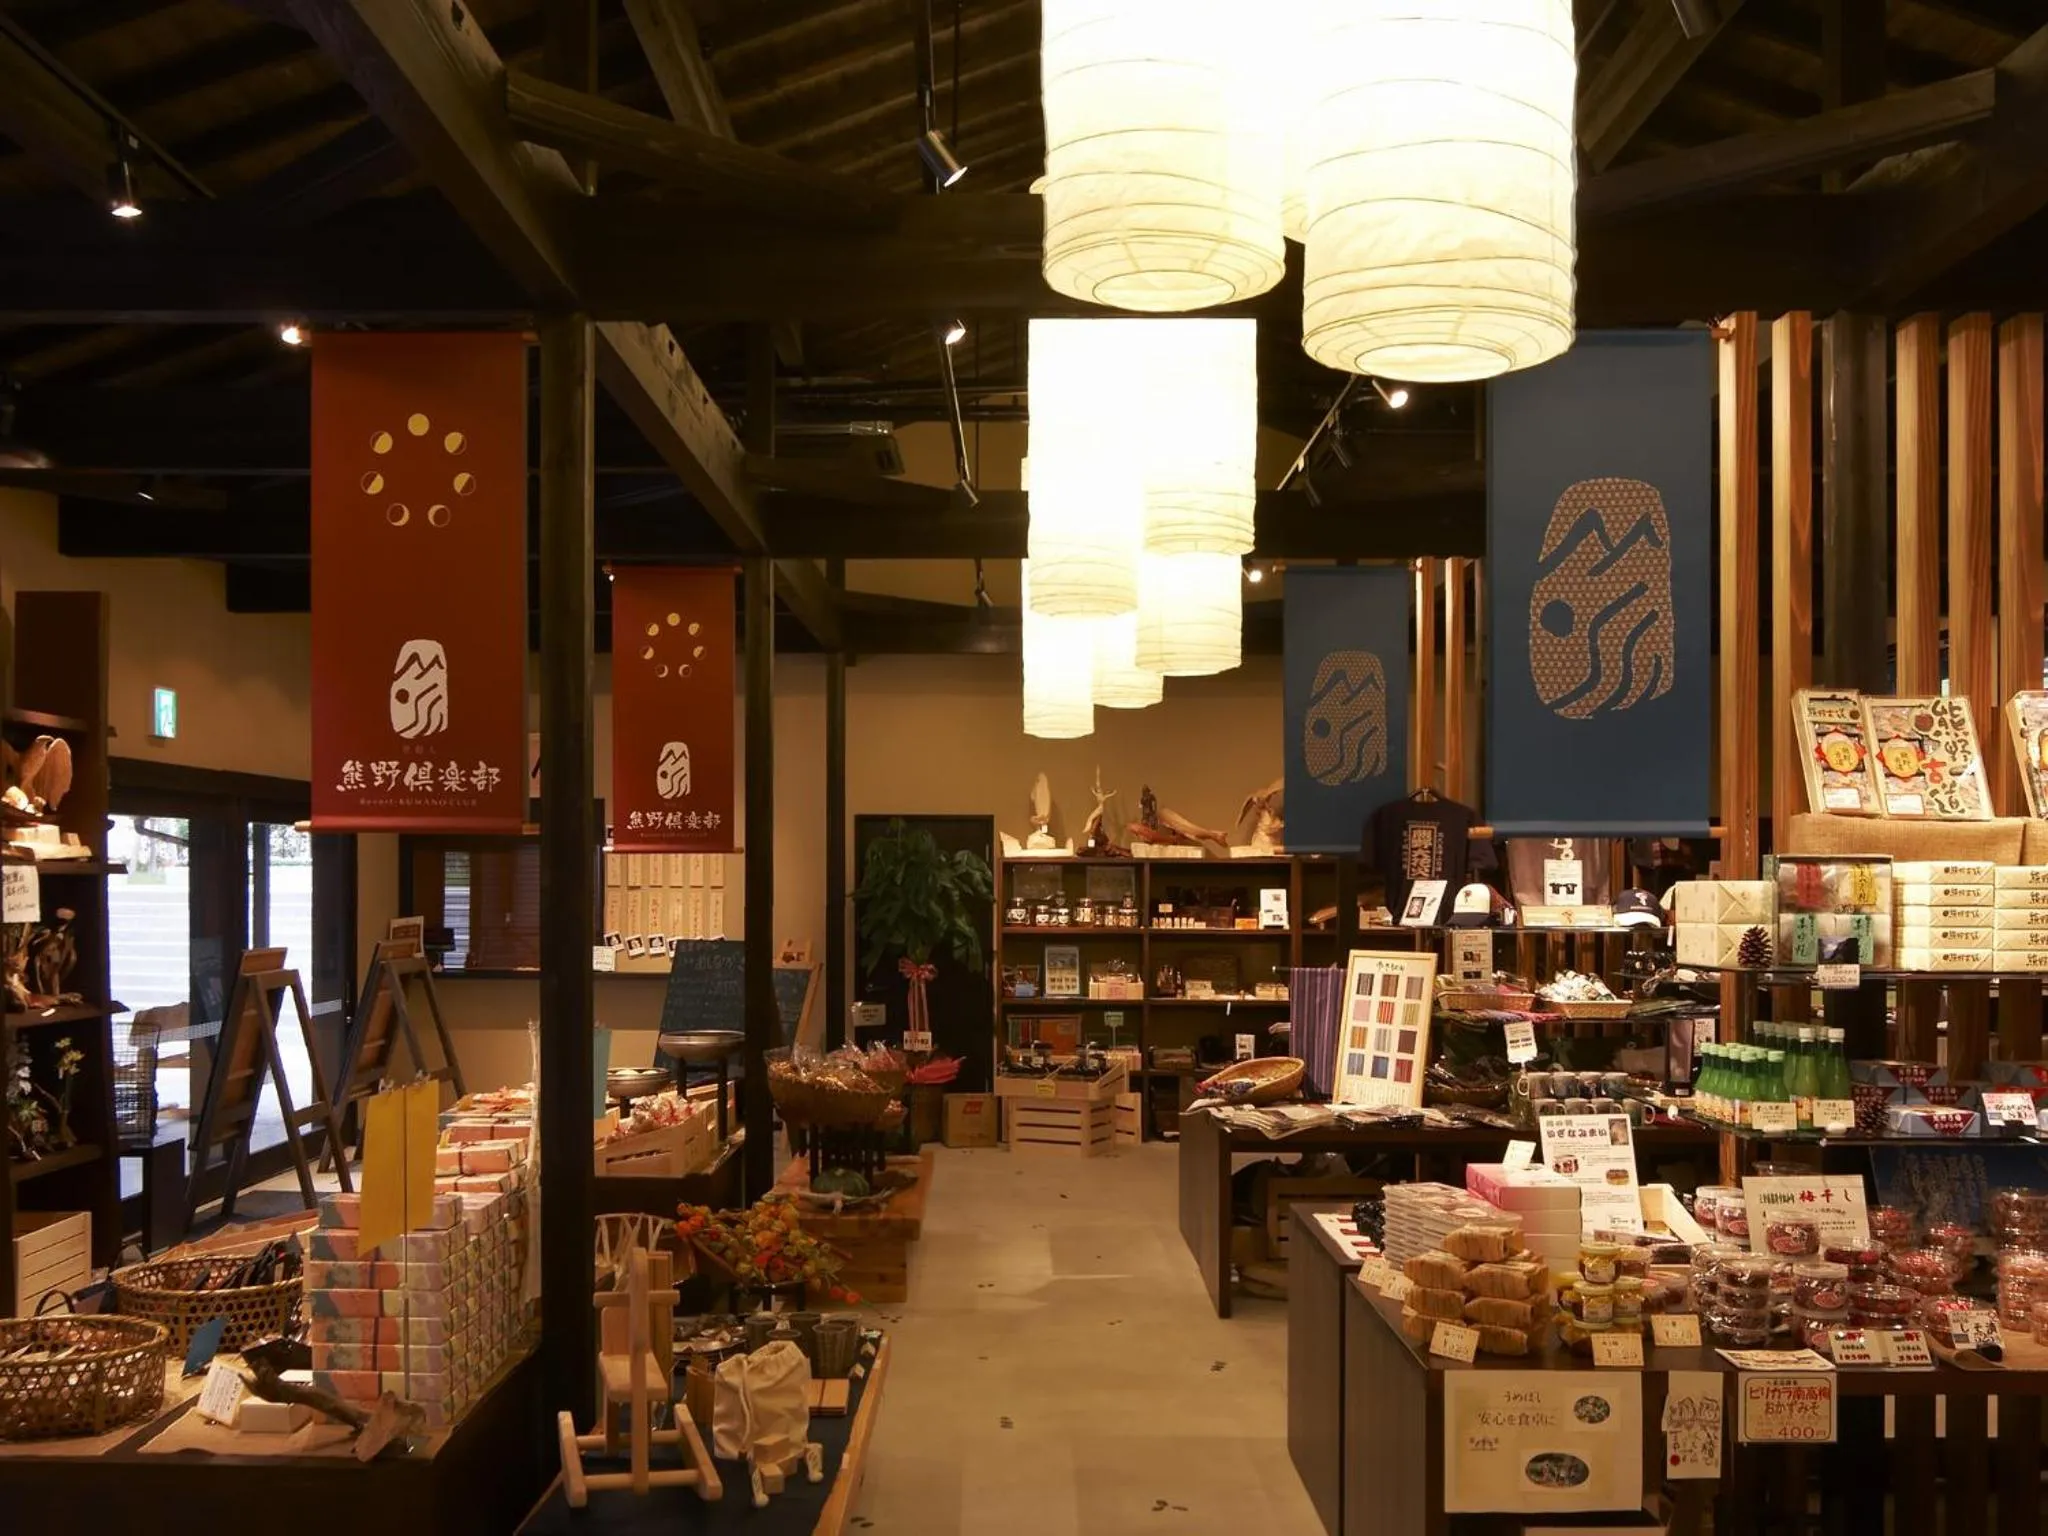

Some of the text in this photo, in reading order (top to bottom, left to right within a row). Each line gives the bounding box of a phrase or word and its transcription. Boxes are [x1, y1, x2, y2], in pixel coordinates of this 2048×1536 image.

[336, 759, 501, 793] 熊野倶楽部
[627, 810, 720, 830] 熊野倶楽部
